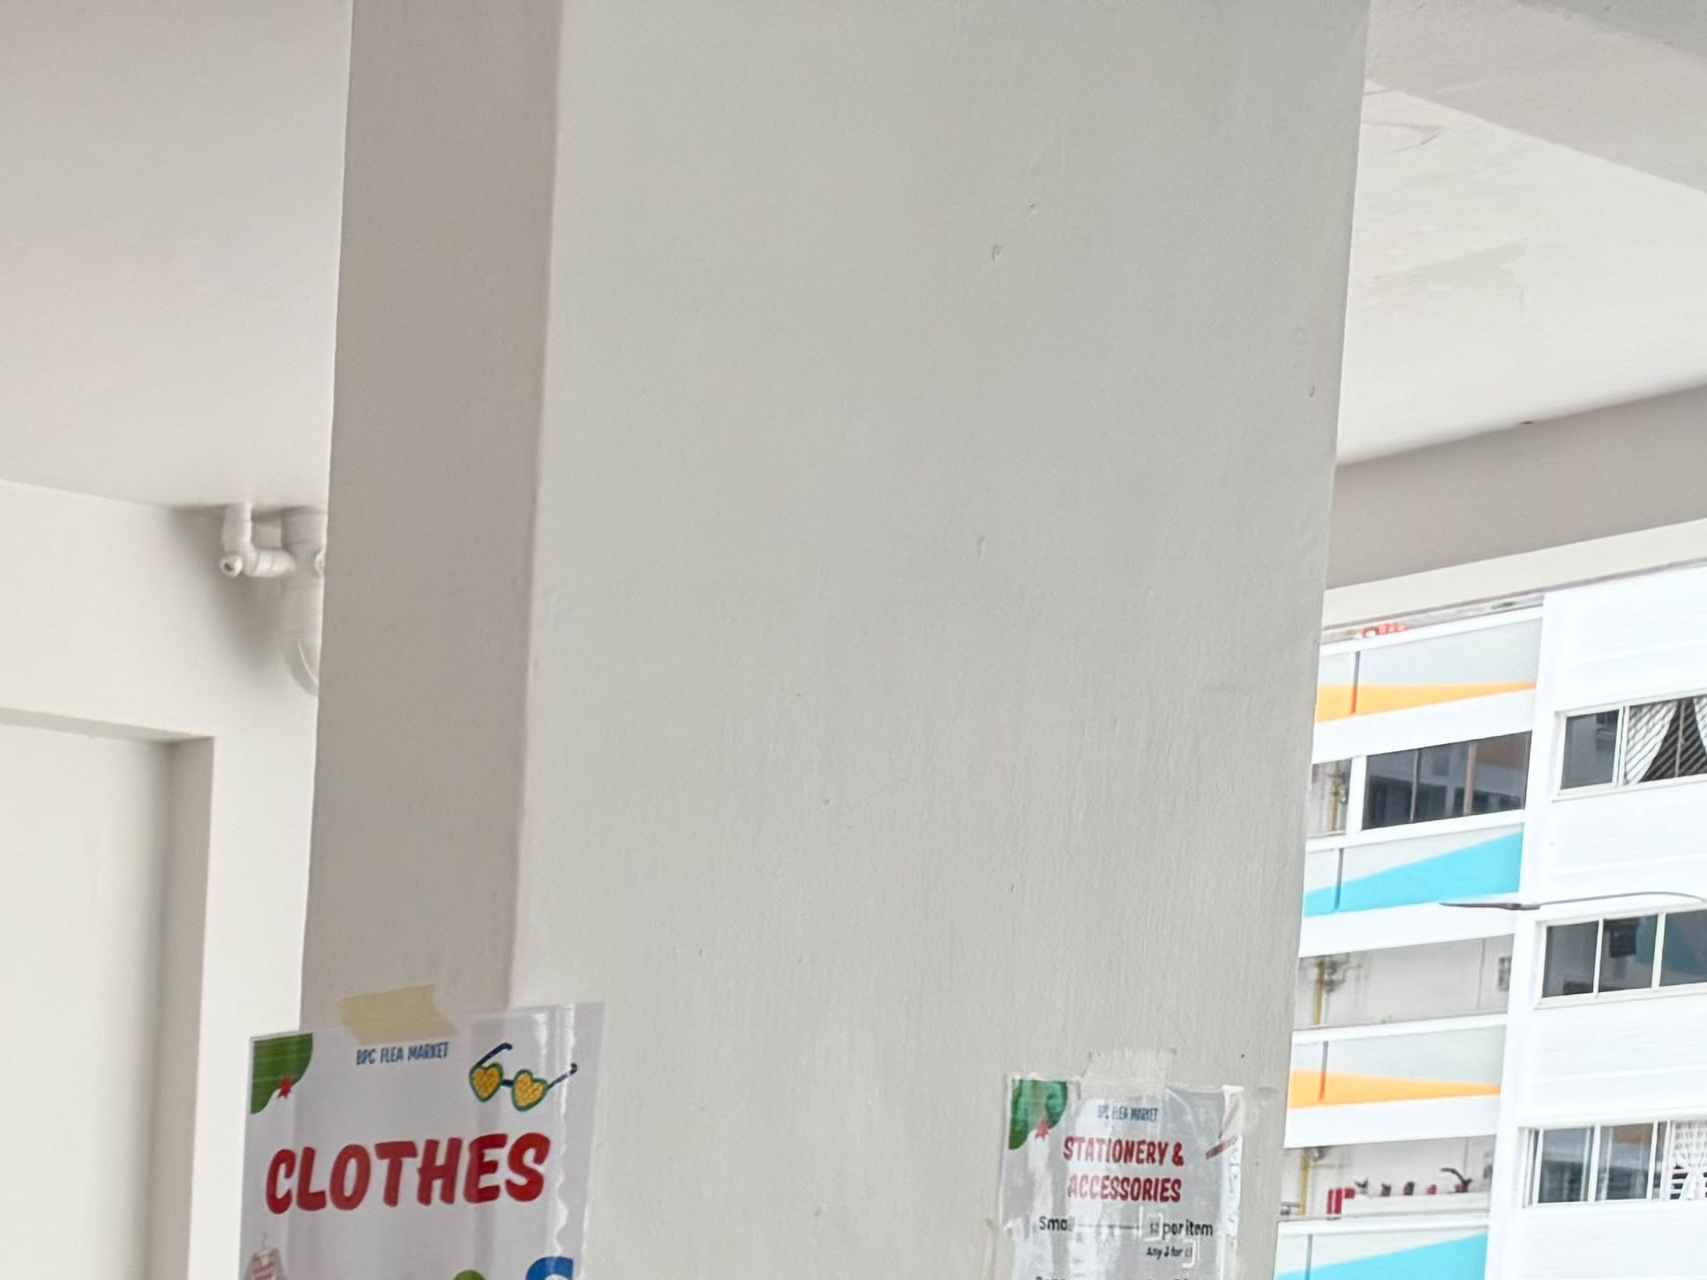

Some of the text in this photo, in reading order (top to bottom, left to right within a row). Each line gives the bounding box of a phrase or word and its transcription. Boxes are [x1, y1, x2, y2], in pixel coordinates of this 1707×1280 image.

[355, 1040, 450, 1066] BPC FLEA MARKET
[1062, 1136, 1185, 1168] STATIONERY &
[265, 1131, 551, 1216] CLOTHES
[1067, 1173, 1183, 1203] ACCESSORIES
[1184, 1218, 1214, 1237] item
